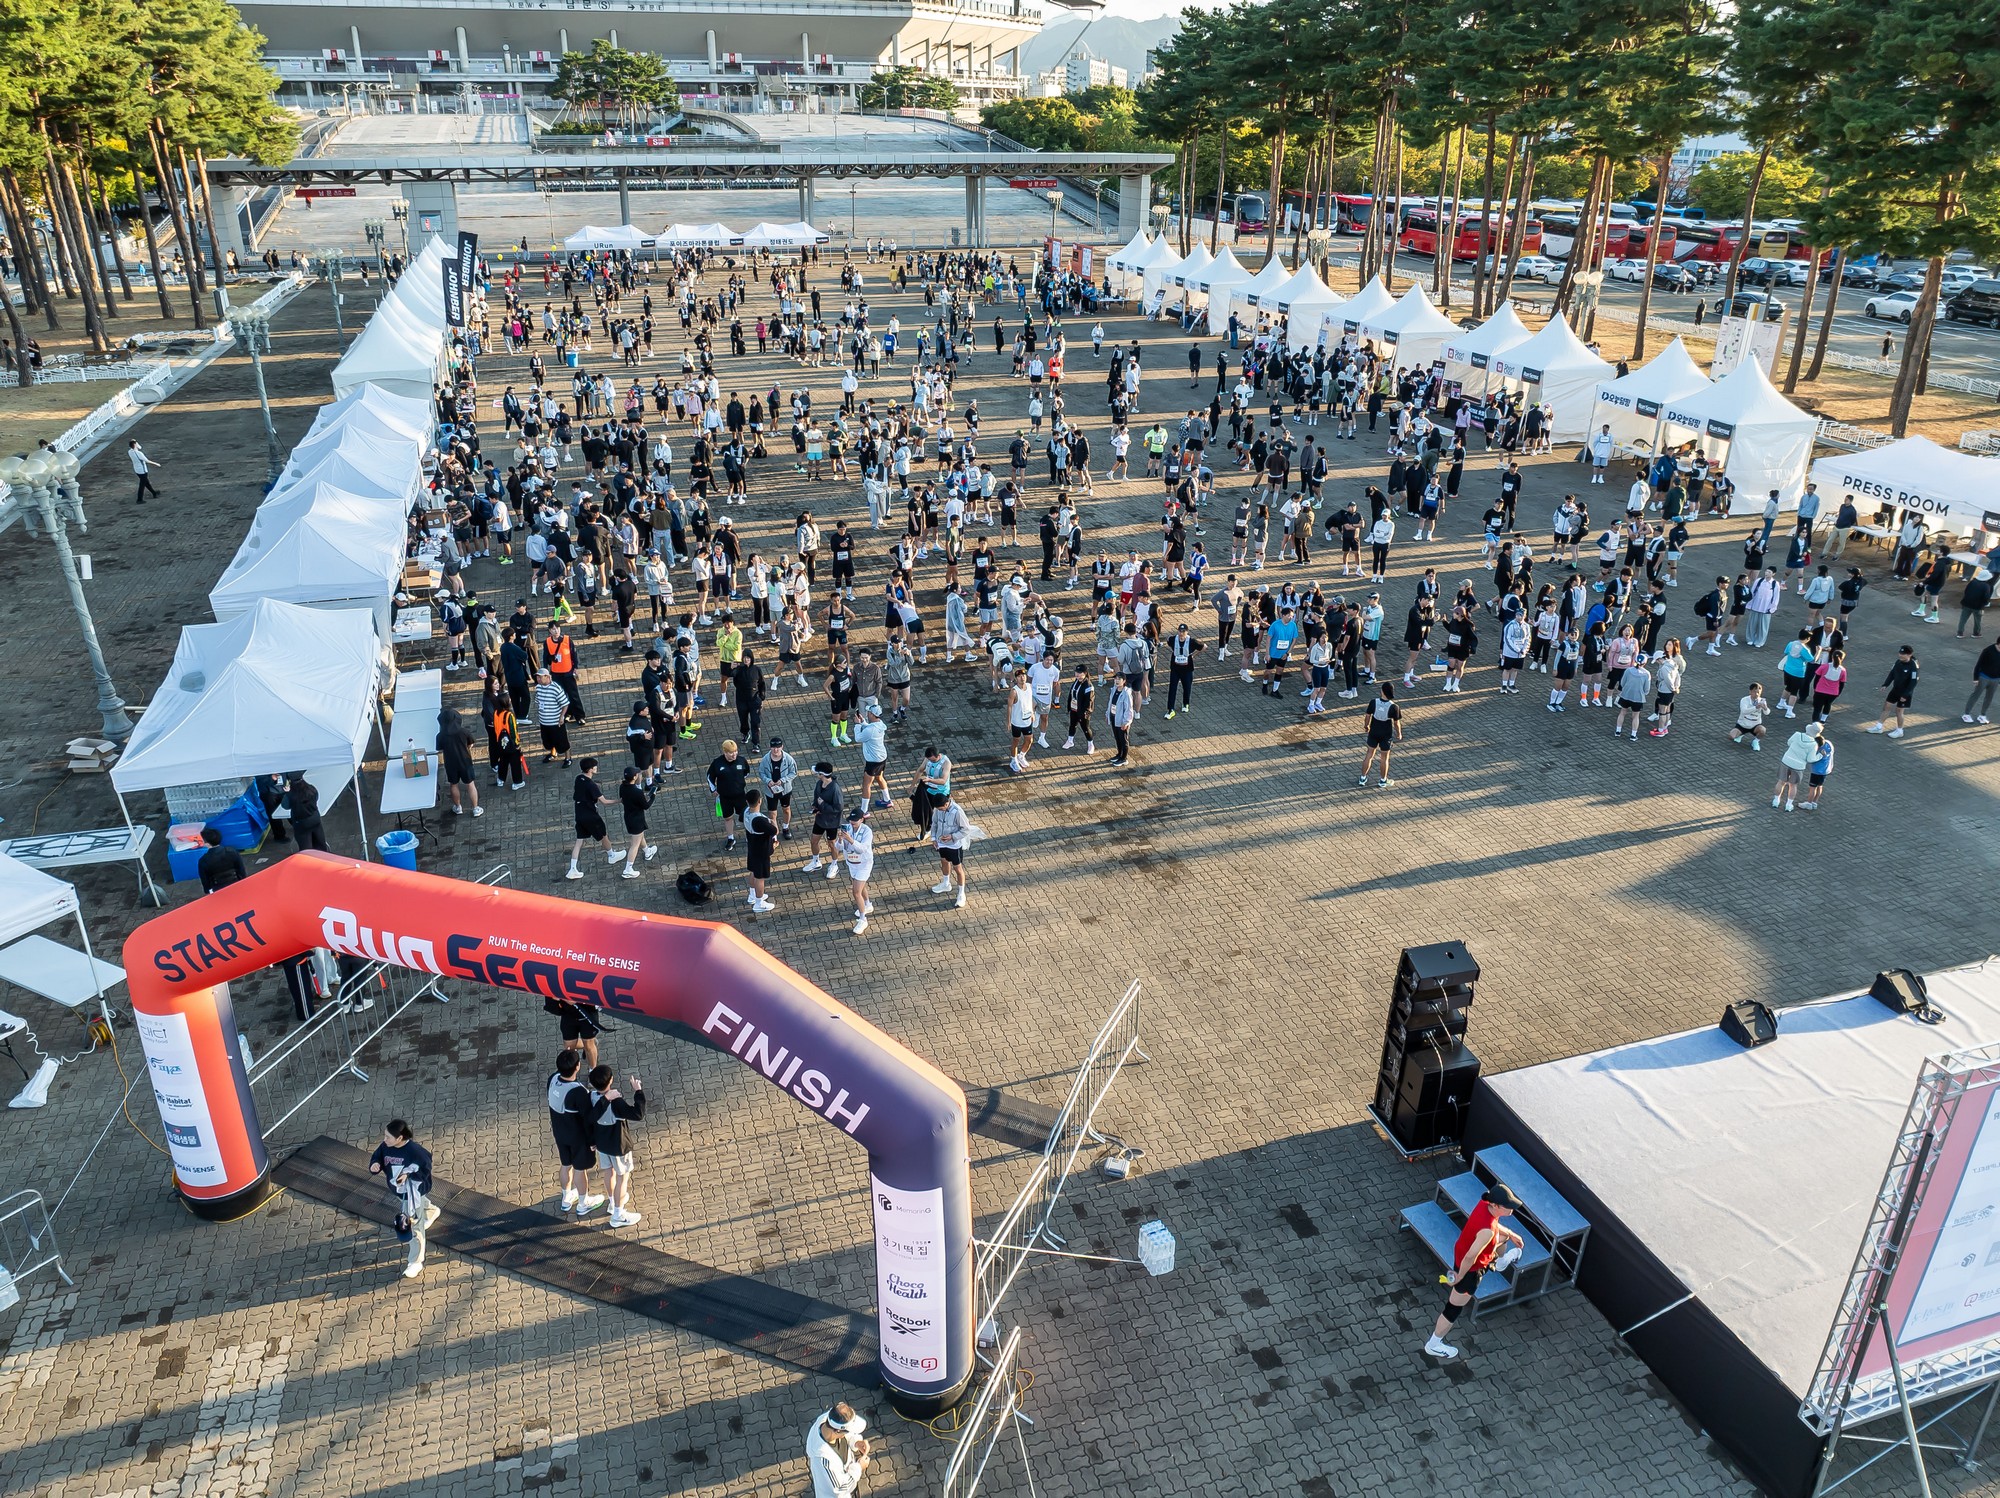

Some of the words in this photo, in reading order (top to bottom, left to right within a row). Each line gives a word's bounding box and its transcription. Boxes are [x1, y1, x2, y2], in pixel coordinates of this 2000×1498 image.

[461, 240, 473, 287] JOHNBER
[448, 267, 461, 320] JOHNBER
[1842, 475, 1893, 500] PRESS
[1897, 491, 1950, 517] ROOM
[153, 909, 267, 983] START
[488, 935, 508, 948] RUN
[510, 939, 528, 952] The
[529, 943, 563, 960] Record,
[566, 950, 586, 962] Feel
[588, 953, 606, 966] The
[608, 957, 640, 972] SENSE
[702, 1000, 871, 1134] FINISH
[165, 1097, 192, 1105] Habitat
[192, 1165, 217, 1174] SENSE
[886, 1279, 928, 1299] Health
[889, 1273, 925, 1289] Choco
[885, 1306, 931, 1327] Reebok
[883, 1344, 920, 1368] 일요신문
